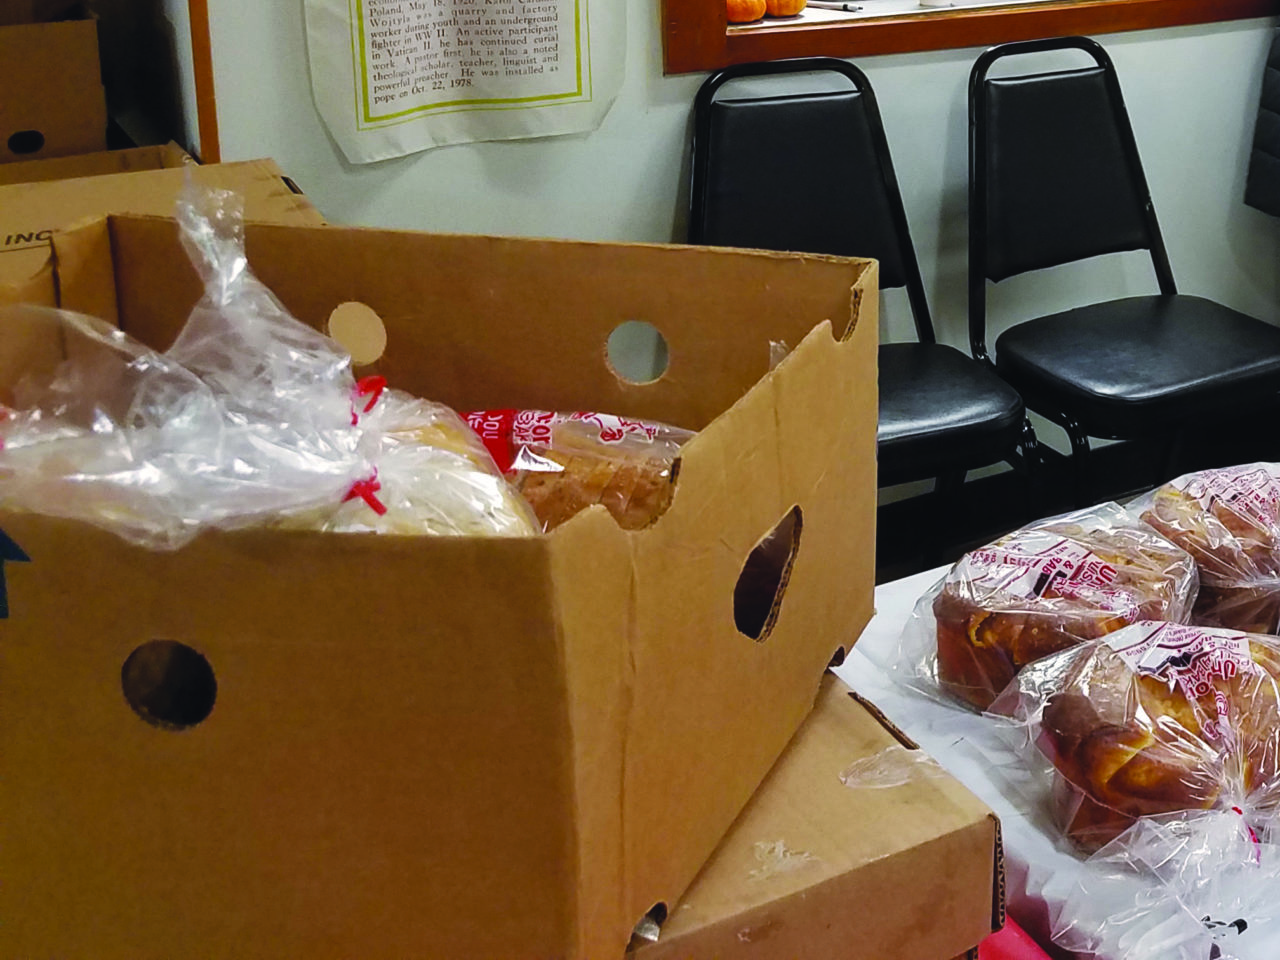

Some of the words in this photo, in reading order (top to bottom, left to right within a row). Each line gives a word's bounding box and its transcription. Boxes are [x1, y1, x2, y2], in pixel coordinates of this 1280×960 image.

[370, 15, 410, 27] Wojtyla
[452, 8, 487, 18] quarry
[496, 6, 514, 15] and
[522, 5, 558, 14] factory
[409, 2, 426, 10] May
[370, 28, 402, 38] worker
[404, 23, 430, 34] during
[432, 18, 458, 30] youth
[464, 17, 481, 26] and
[485, 18, 496, 26] an
[500, 13, 558, 24] underground
[371, 39, 400, 50] fighter
[404, 36, 412, 44] in
[415, 30, 432, 41] WW
[456, 27, 470, 36] An
[474, 26, 504, 36] active
[508, 25, 558, 36] participant
[372, 50, 381, 60] in
[387, 46, 418, 58] Vatican
[440, 39, 450, 48] he
[457, 37, 474, 46] has
[480, 36, 527, 46] continued
[406, 56, 411, 64] A
[414, 52, 439, 64] pastor
[470, 48, 481, 56] he
[488, 48, 494, 56] is
[498, 48, 518, 56] also
[534, 43, 558, 54] noted
[373, 66, 417, 82] theological
[459, 58, 497, 68] teacher,
[503, 56, 537, 66] linguist
[542, 53, 558, 62] and
[374, 78, 410, 94] powerful
[461, 68, 476, 78] He
[505, 65, 544, 76] installed
[374, 94, 396, 104] pope
[399, 90, 408, 98] on
[432, 80, 446, 91] 22,
